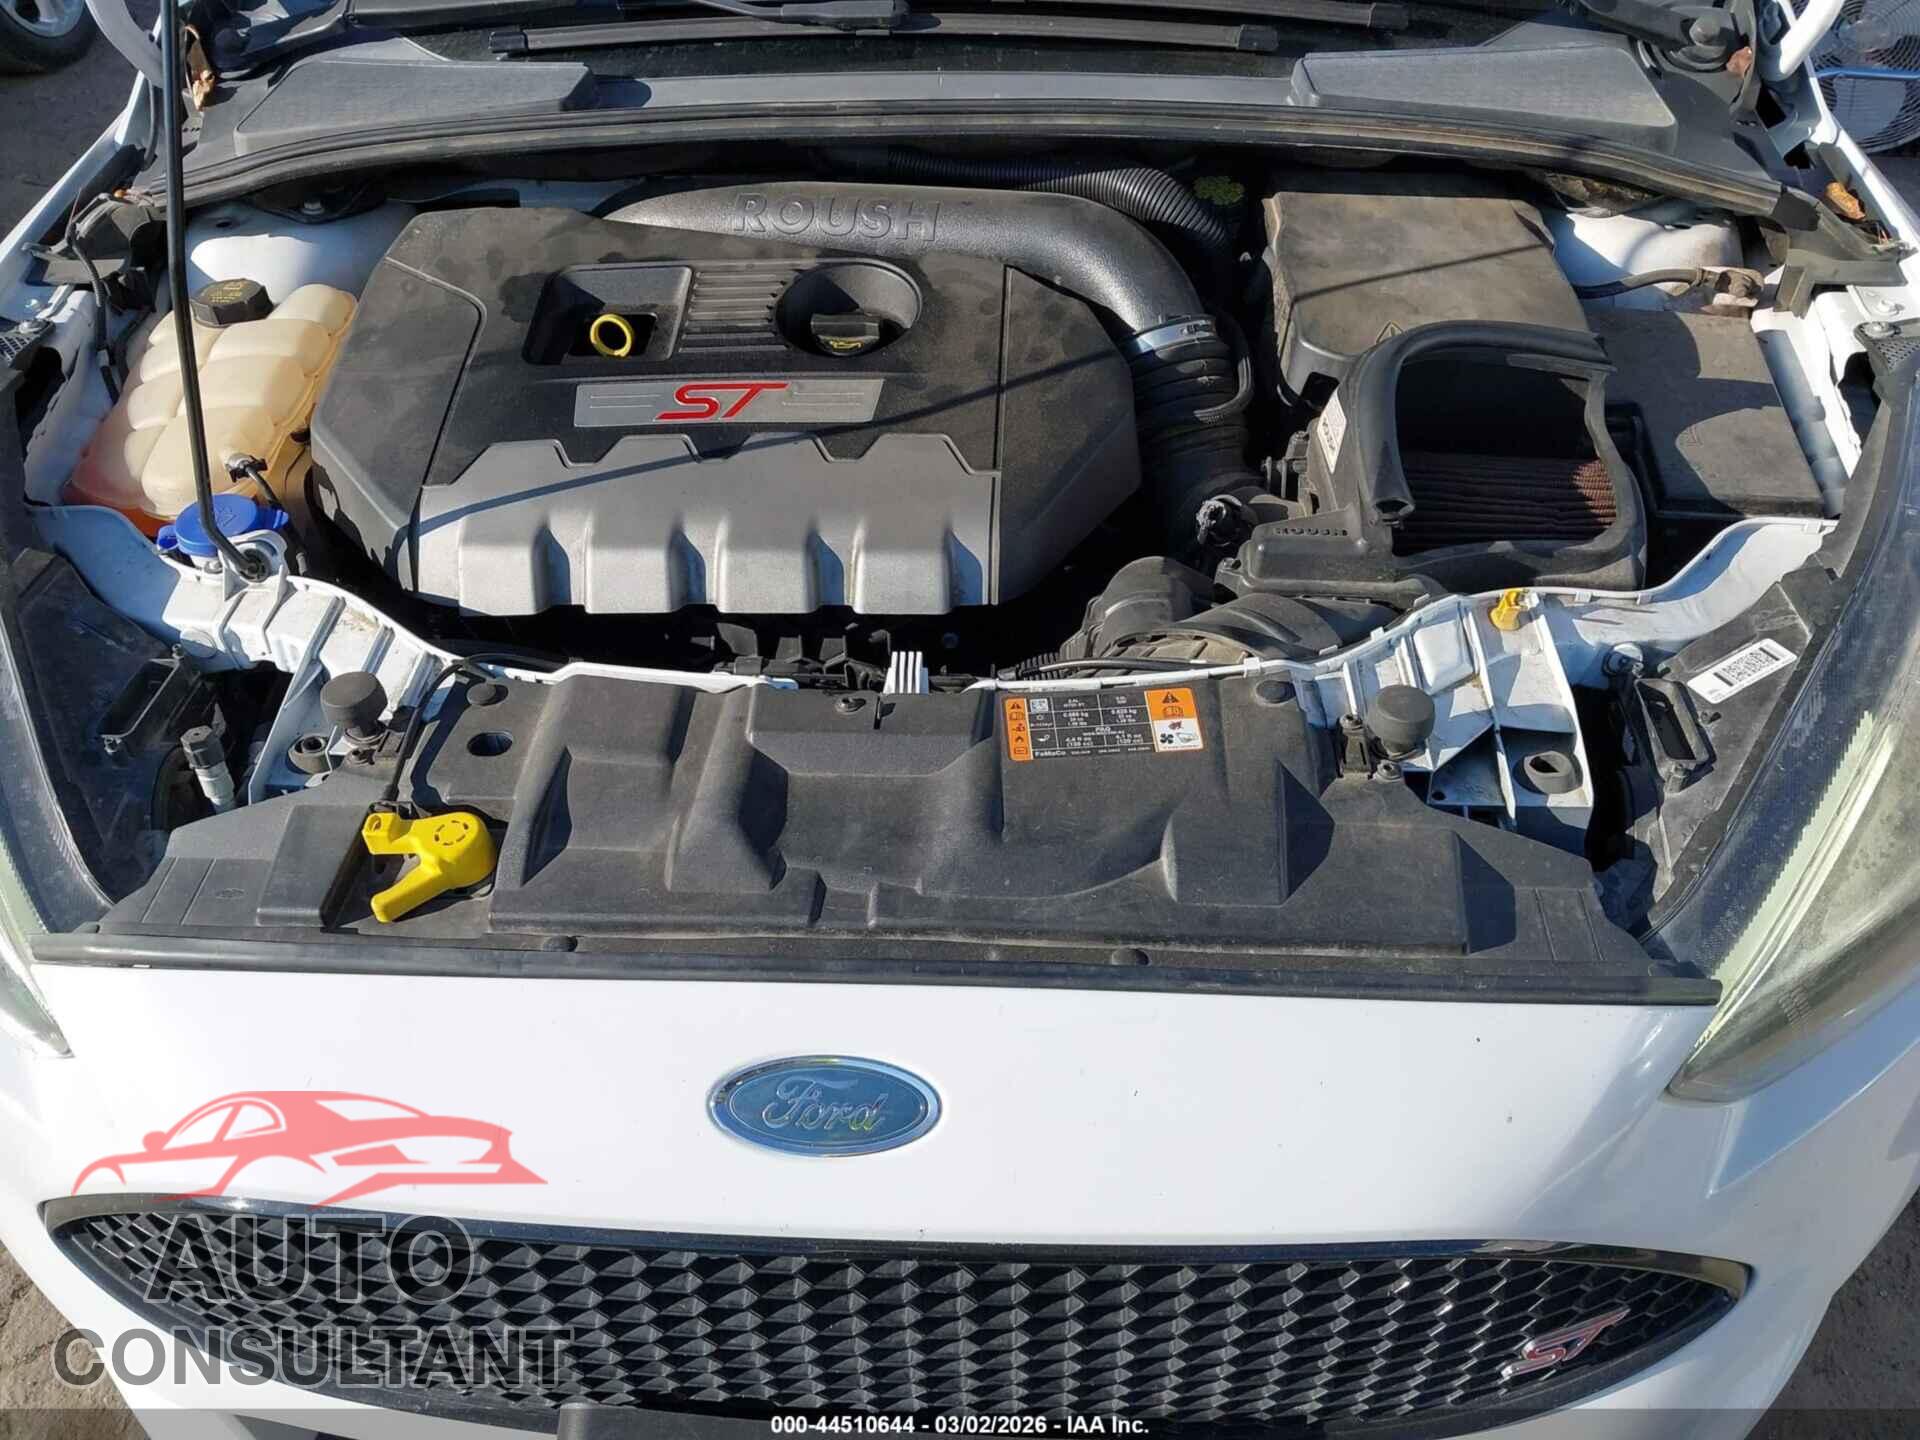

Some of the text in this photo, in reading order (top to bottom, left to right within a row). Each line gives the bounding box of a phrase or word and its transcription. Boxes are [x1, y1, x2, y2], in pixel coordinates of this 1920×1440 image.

[734, 193, 941, 242] ROUSH
[652, 382, 791, 422] ST
[762, 1075, 888, 1131] Ford
[1501, 1305, 1630, 1377] ST
